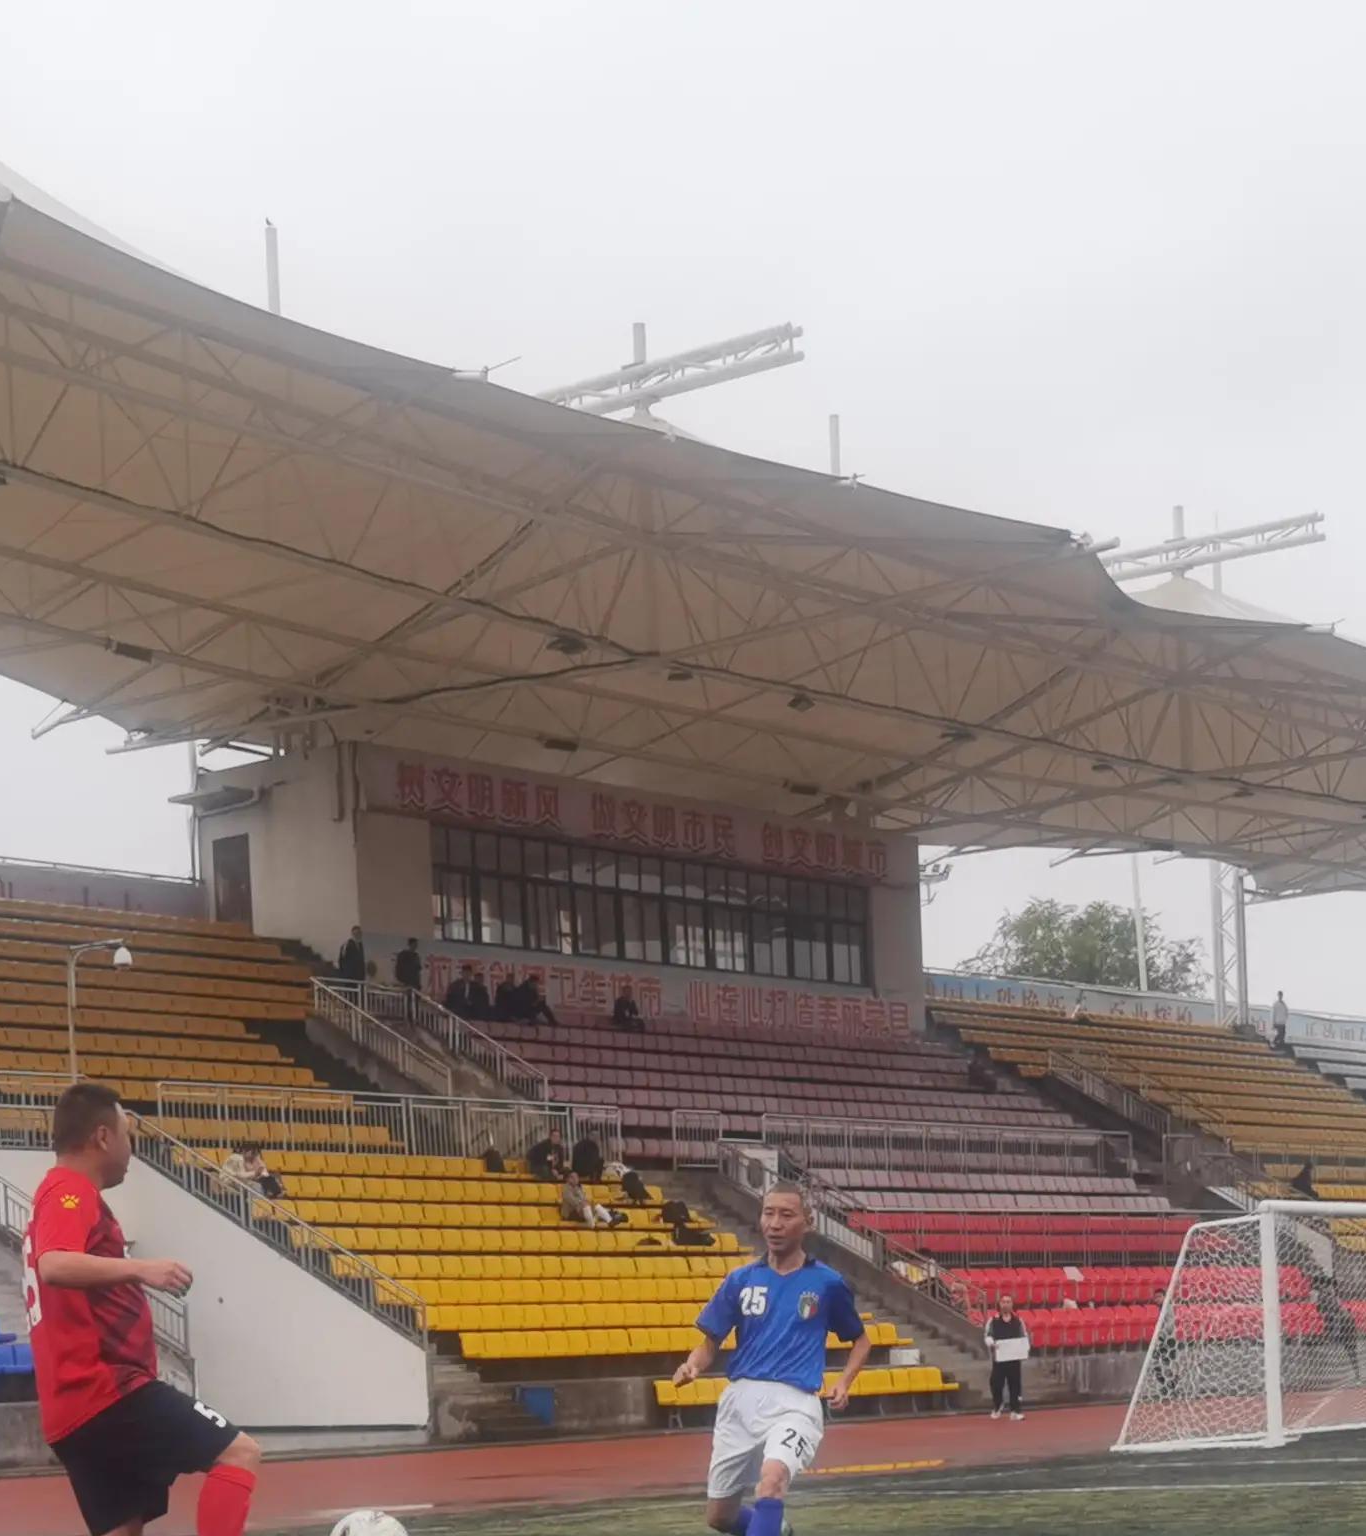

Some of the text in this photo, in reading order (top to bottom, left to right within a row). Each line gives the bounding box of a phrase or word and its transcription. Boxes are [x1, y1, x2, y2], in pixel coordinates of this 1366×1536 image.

[738, 1285, 768, 1316] 25
[193, 1400, 227, 1428] 5
[780, 1427, 807, 1458] 25
